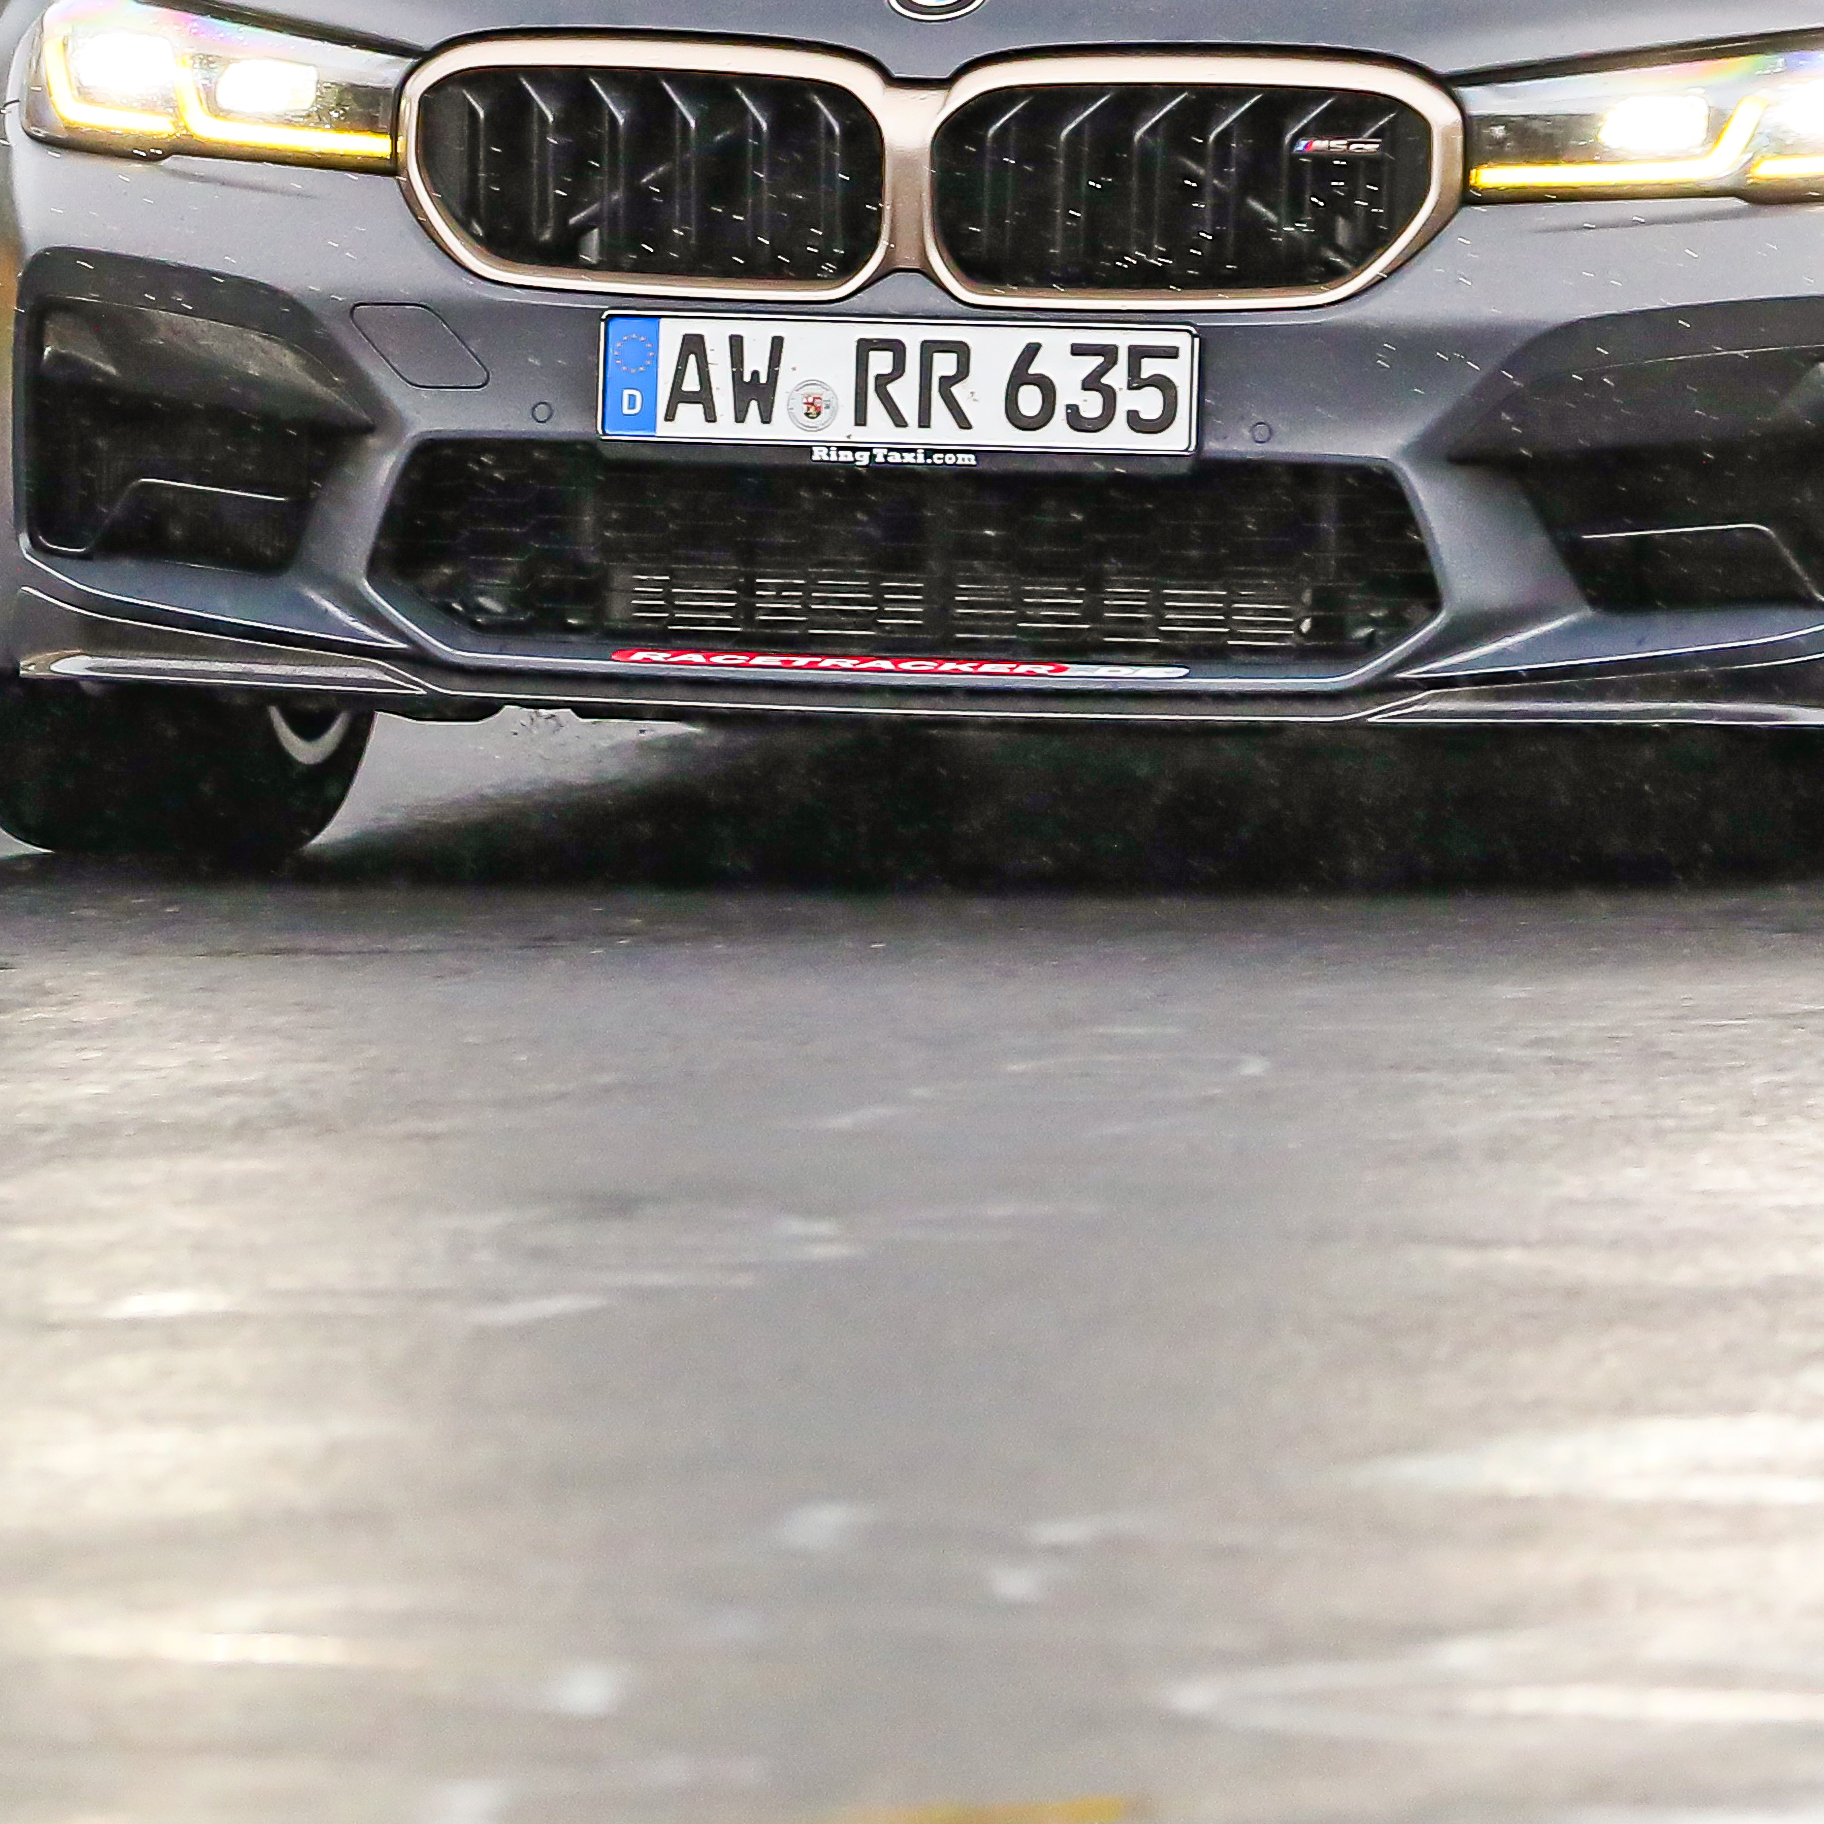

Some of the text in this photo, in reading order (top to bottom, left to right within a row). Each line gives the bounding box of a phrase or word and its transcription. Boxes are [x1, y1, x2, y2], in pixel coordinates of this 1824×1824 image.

[621, 332, 1180, 434] D AW RR 635
